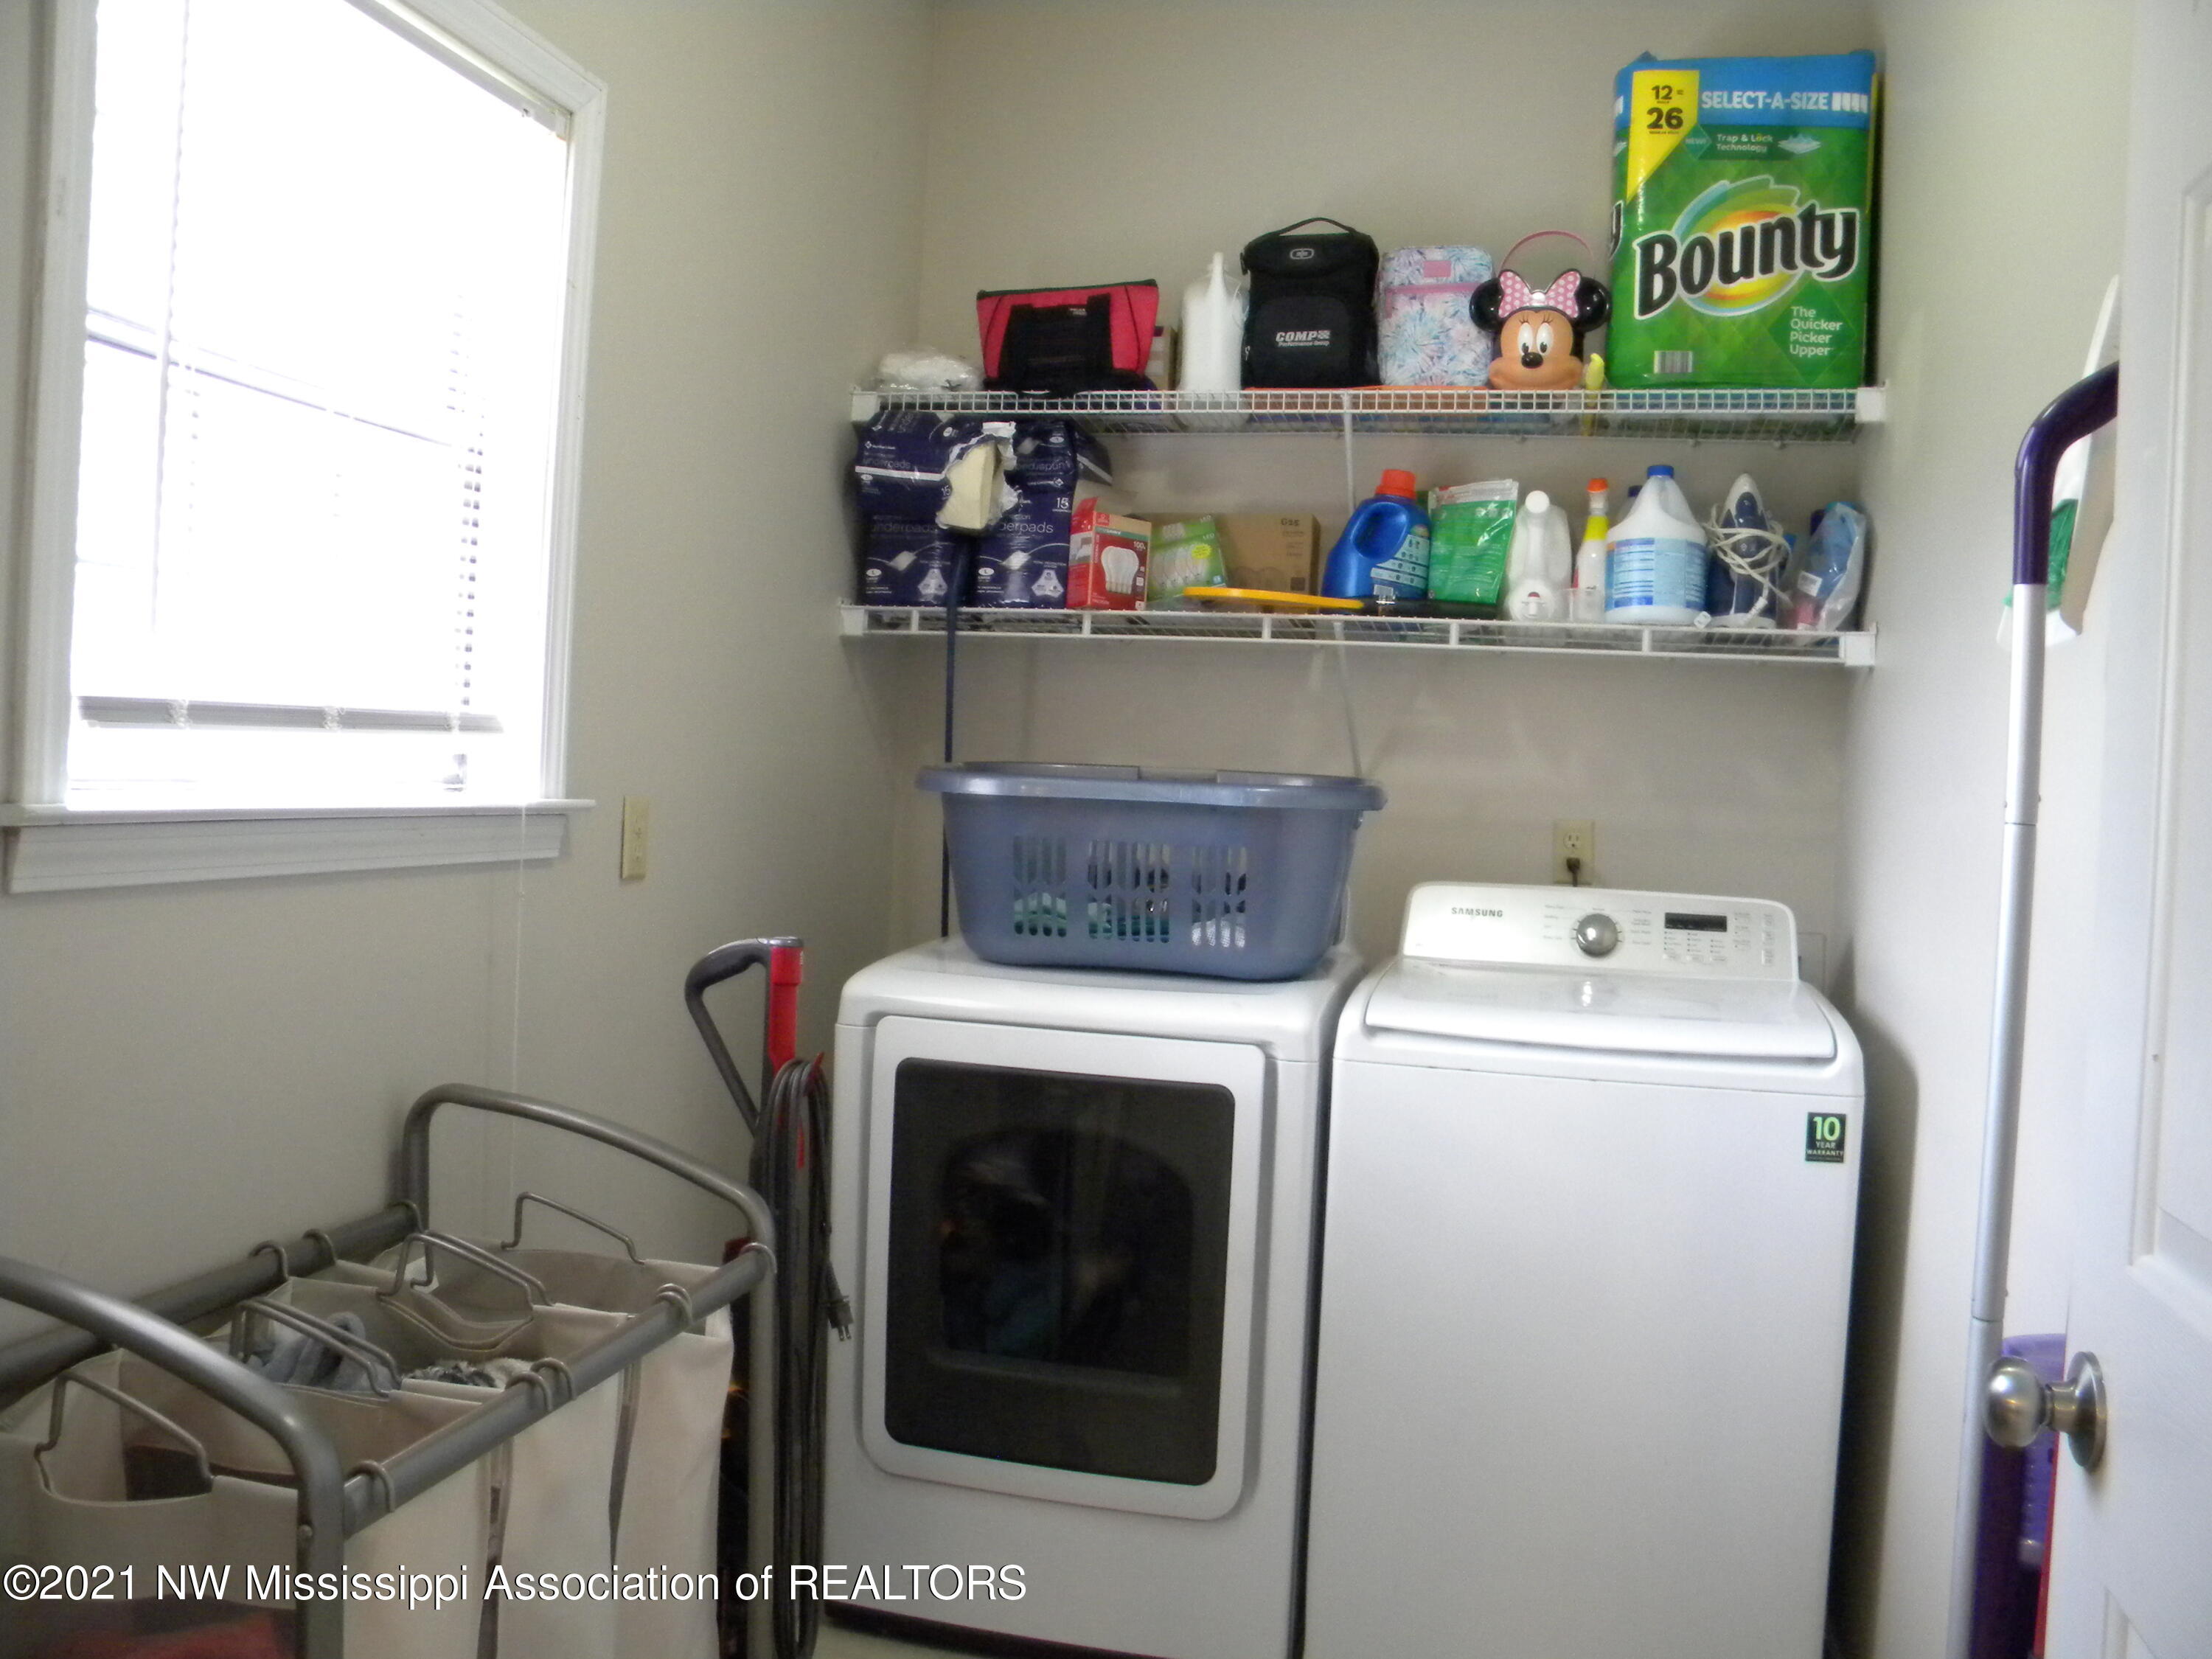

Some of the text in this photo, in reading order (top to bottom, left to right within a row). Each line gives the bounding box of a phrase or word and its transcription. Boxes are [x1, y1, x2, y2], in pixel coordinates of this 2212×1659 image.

[1652, 85, 1673, 100] 12
[1702, 91, 1829, 110] SELECT-A-SIZE
[1646, 107, 1684, 130] 26
[1717, 133, 1773, 143] Trap & Lock
[1717, 143, 1767, 152] Technology
[1632, 200, 1859, 319] Bounty
[1791, 305, 1816, 317] The
[1790, 318, 1843, 330] Quicker
[1790, 331, 1832, 343] Picker
[1790, 344, 1830, 358] Upper
[1057, 497, 1069, 509] 15
[1451, 907, 1503, 918] SAMSUNG
[1813, 1116, 1840, 1141] 10
